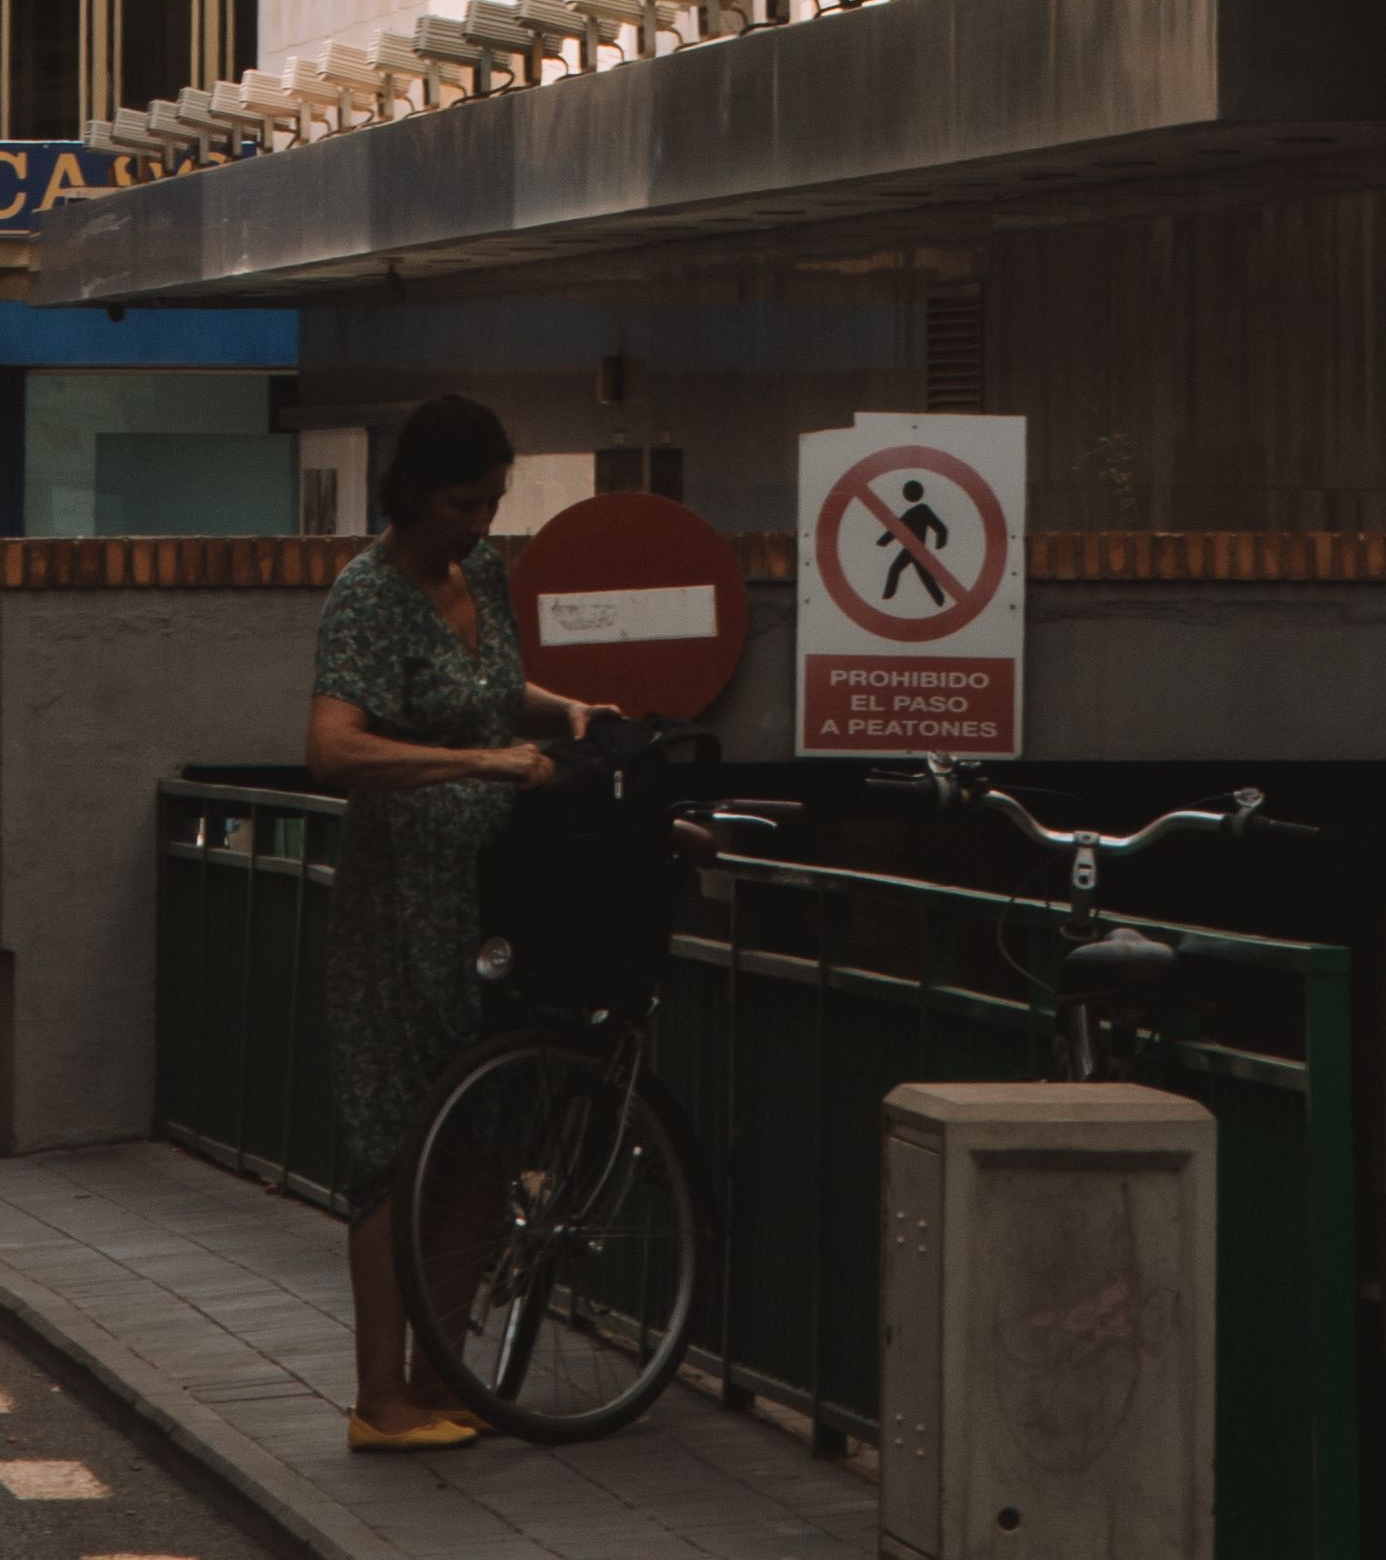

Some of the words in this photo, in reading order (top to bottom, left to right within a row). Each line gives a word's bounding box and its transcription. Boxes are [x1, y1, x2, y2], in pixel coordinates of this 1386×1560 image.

[830, 669, 989, 689] PROHIBIDO
[850, 694, 885, 711] EL
[893, 695, 968, 713] PASO
[820, 719, 840, 735] A
[847, 719, 998, 738] PEATONES
